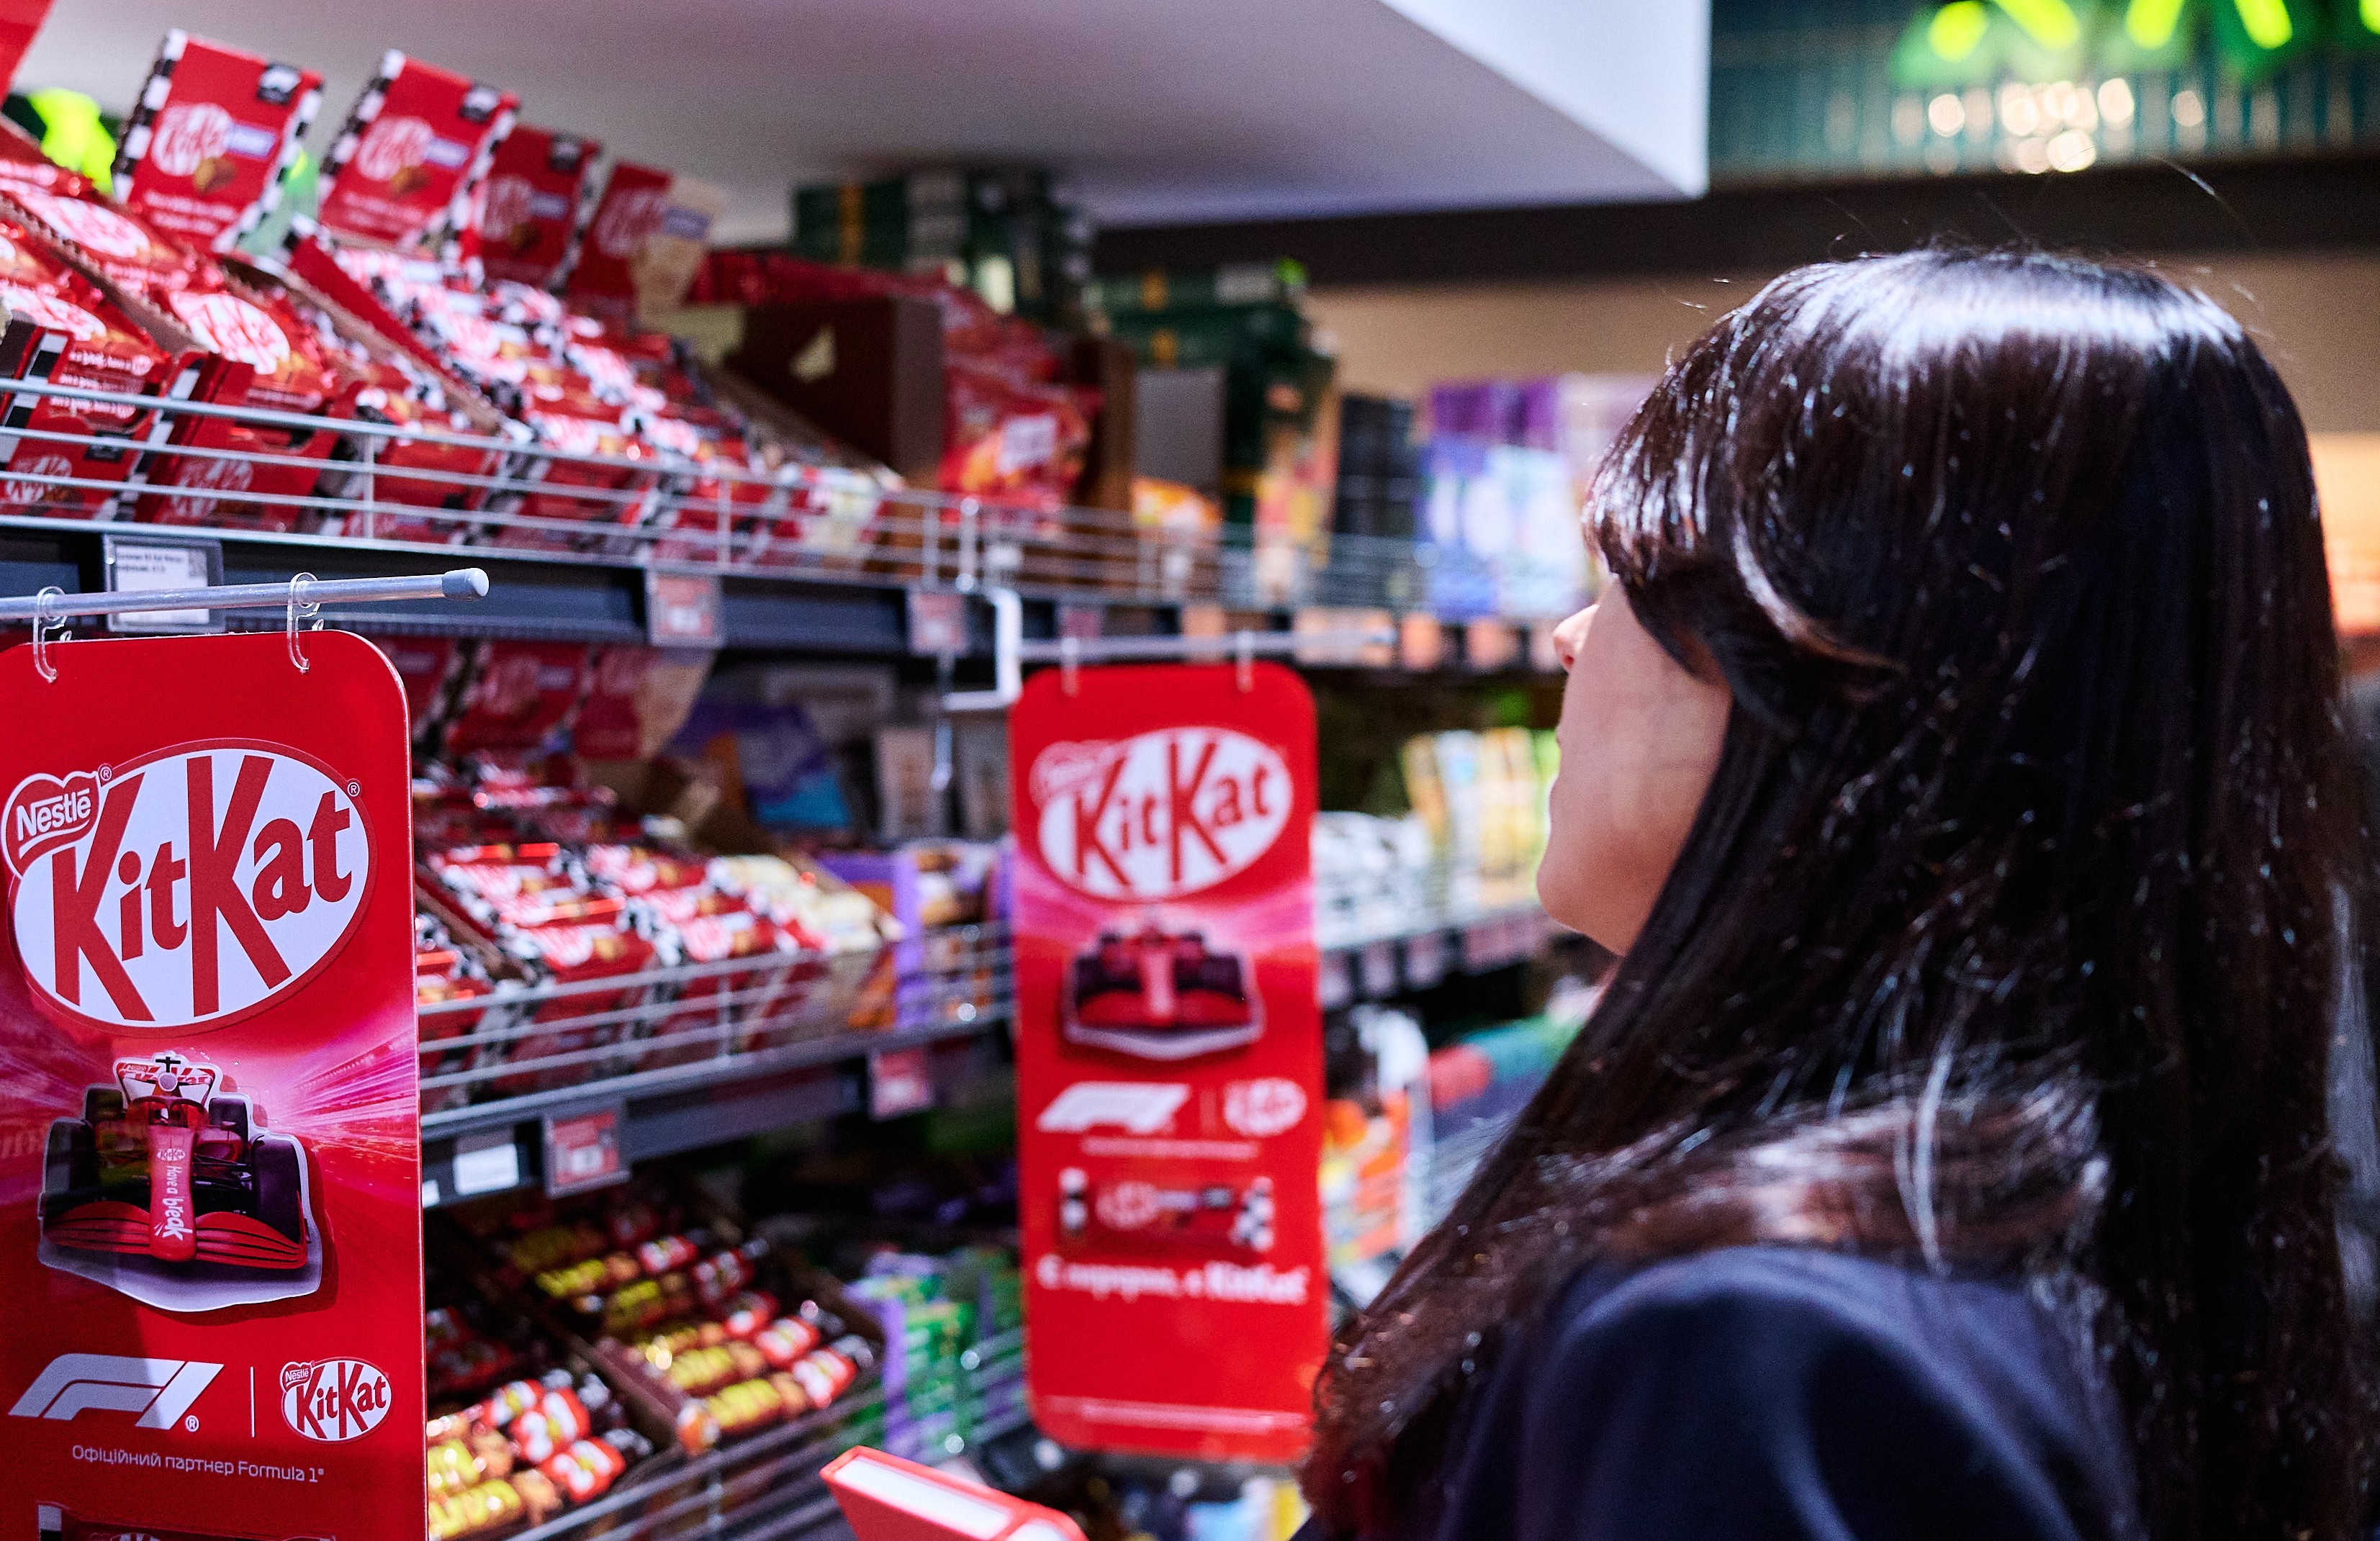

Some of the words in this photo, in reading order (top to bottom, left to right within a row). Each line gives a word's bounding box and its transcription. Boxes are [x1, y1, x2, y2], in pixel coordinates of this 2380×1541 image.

[1073, 742, 1271, 886] KitKat
[52, 755, 352, 1021] KitKat
[166, 1165, 182, 1186] Have
[162, 1196, 193, 1241] break
[296, 1362, 387, 1440] KitKat
[72, 1445, 161, 1467] Офіційний
[165, 1456, 234, 1476] партнер
[238, 1460, 305, 1481] Formula
